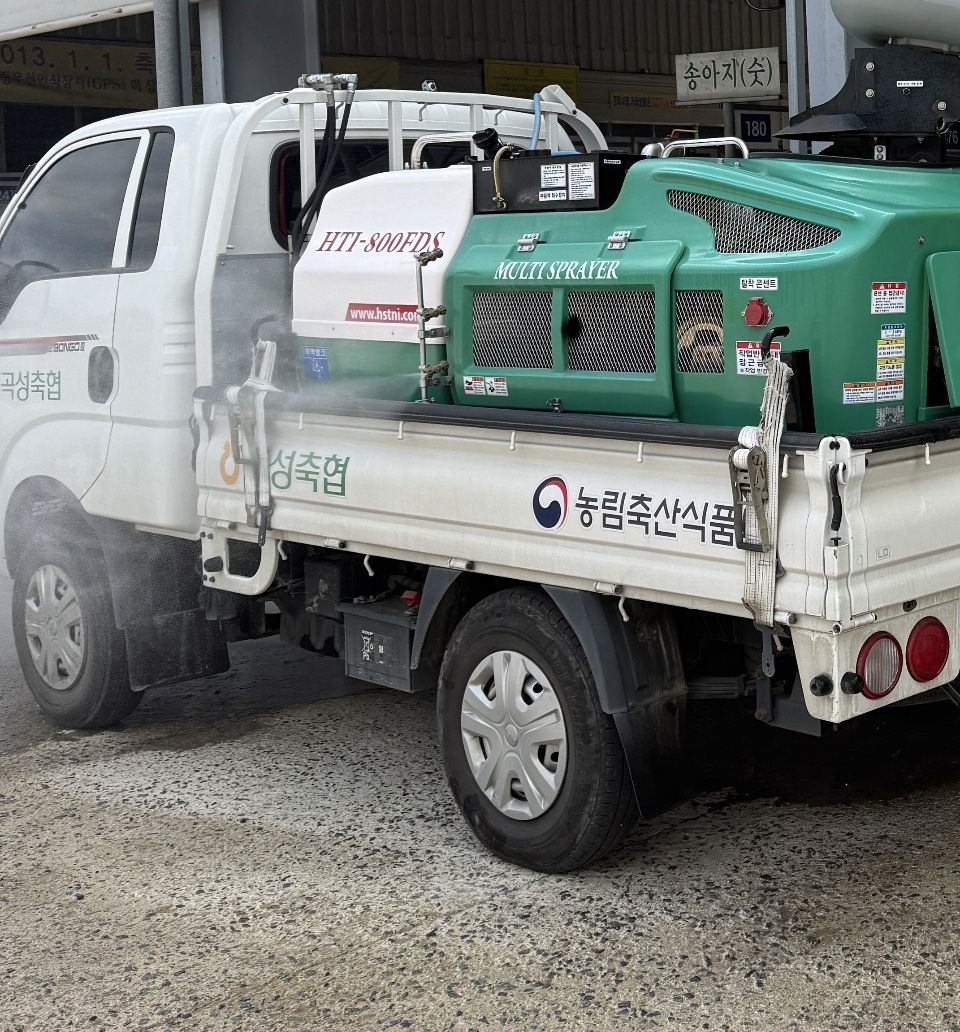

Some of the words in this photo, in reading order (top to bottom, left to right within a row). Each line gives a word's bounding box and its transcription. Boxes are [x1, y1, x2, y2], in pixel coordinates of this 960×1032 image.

[745, 121, 767, 137] 180
[315, 231, 446, 253] HTI-800FDS
[493, 261, 548, 280] MULTI
[547, 260, 620, 280] SPRAYER
[0, 370, 61, 401] 곡성축협
[269, 449, 350, 497] 성축협
